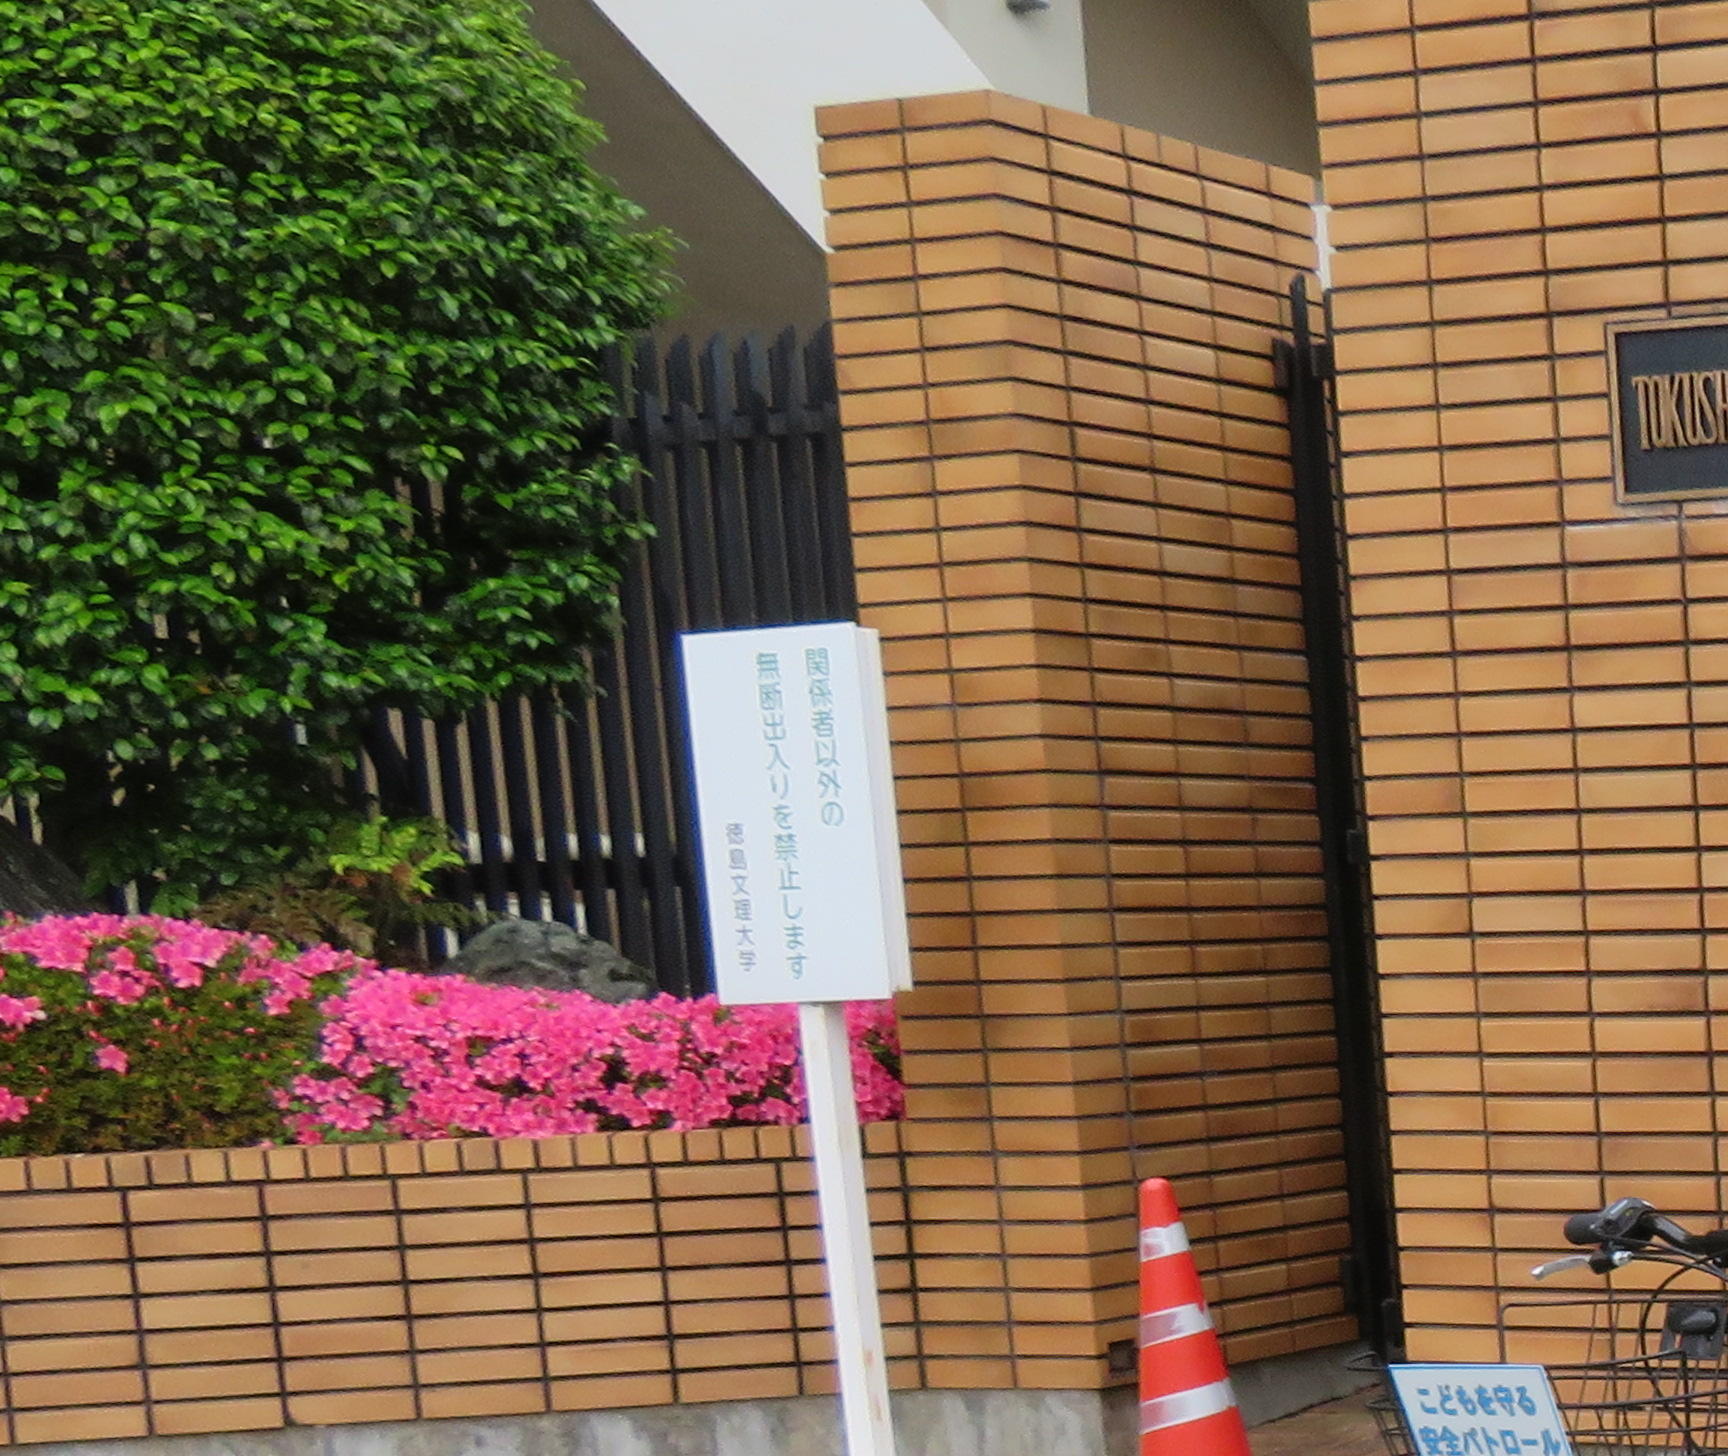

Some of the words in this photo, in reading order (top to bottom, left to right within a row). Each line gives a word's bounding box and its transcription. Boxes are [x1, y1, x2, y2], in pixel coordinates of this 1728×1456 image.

[804, 647, 845, 827] 関係者以外の
[756, 652, 808, 981] 無断出入りを禁止します
[1417, 1384, 1537, 1416] こどもを守る
[1418, 1425, 1562, 1456] 安全パトロール
